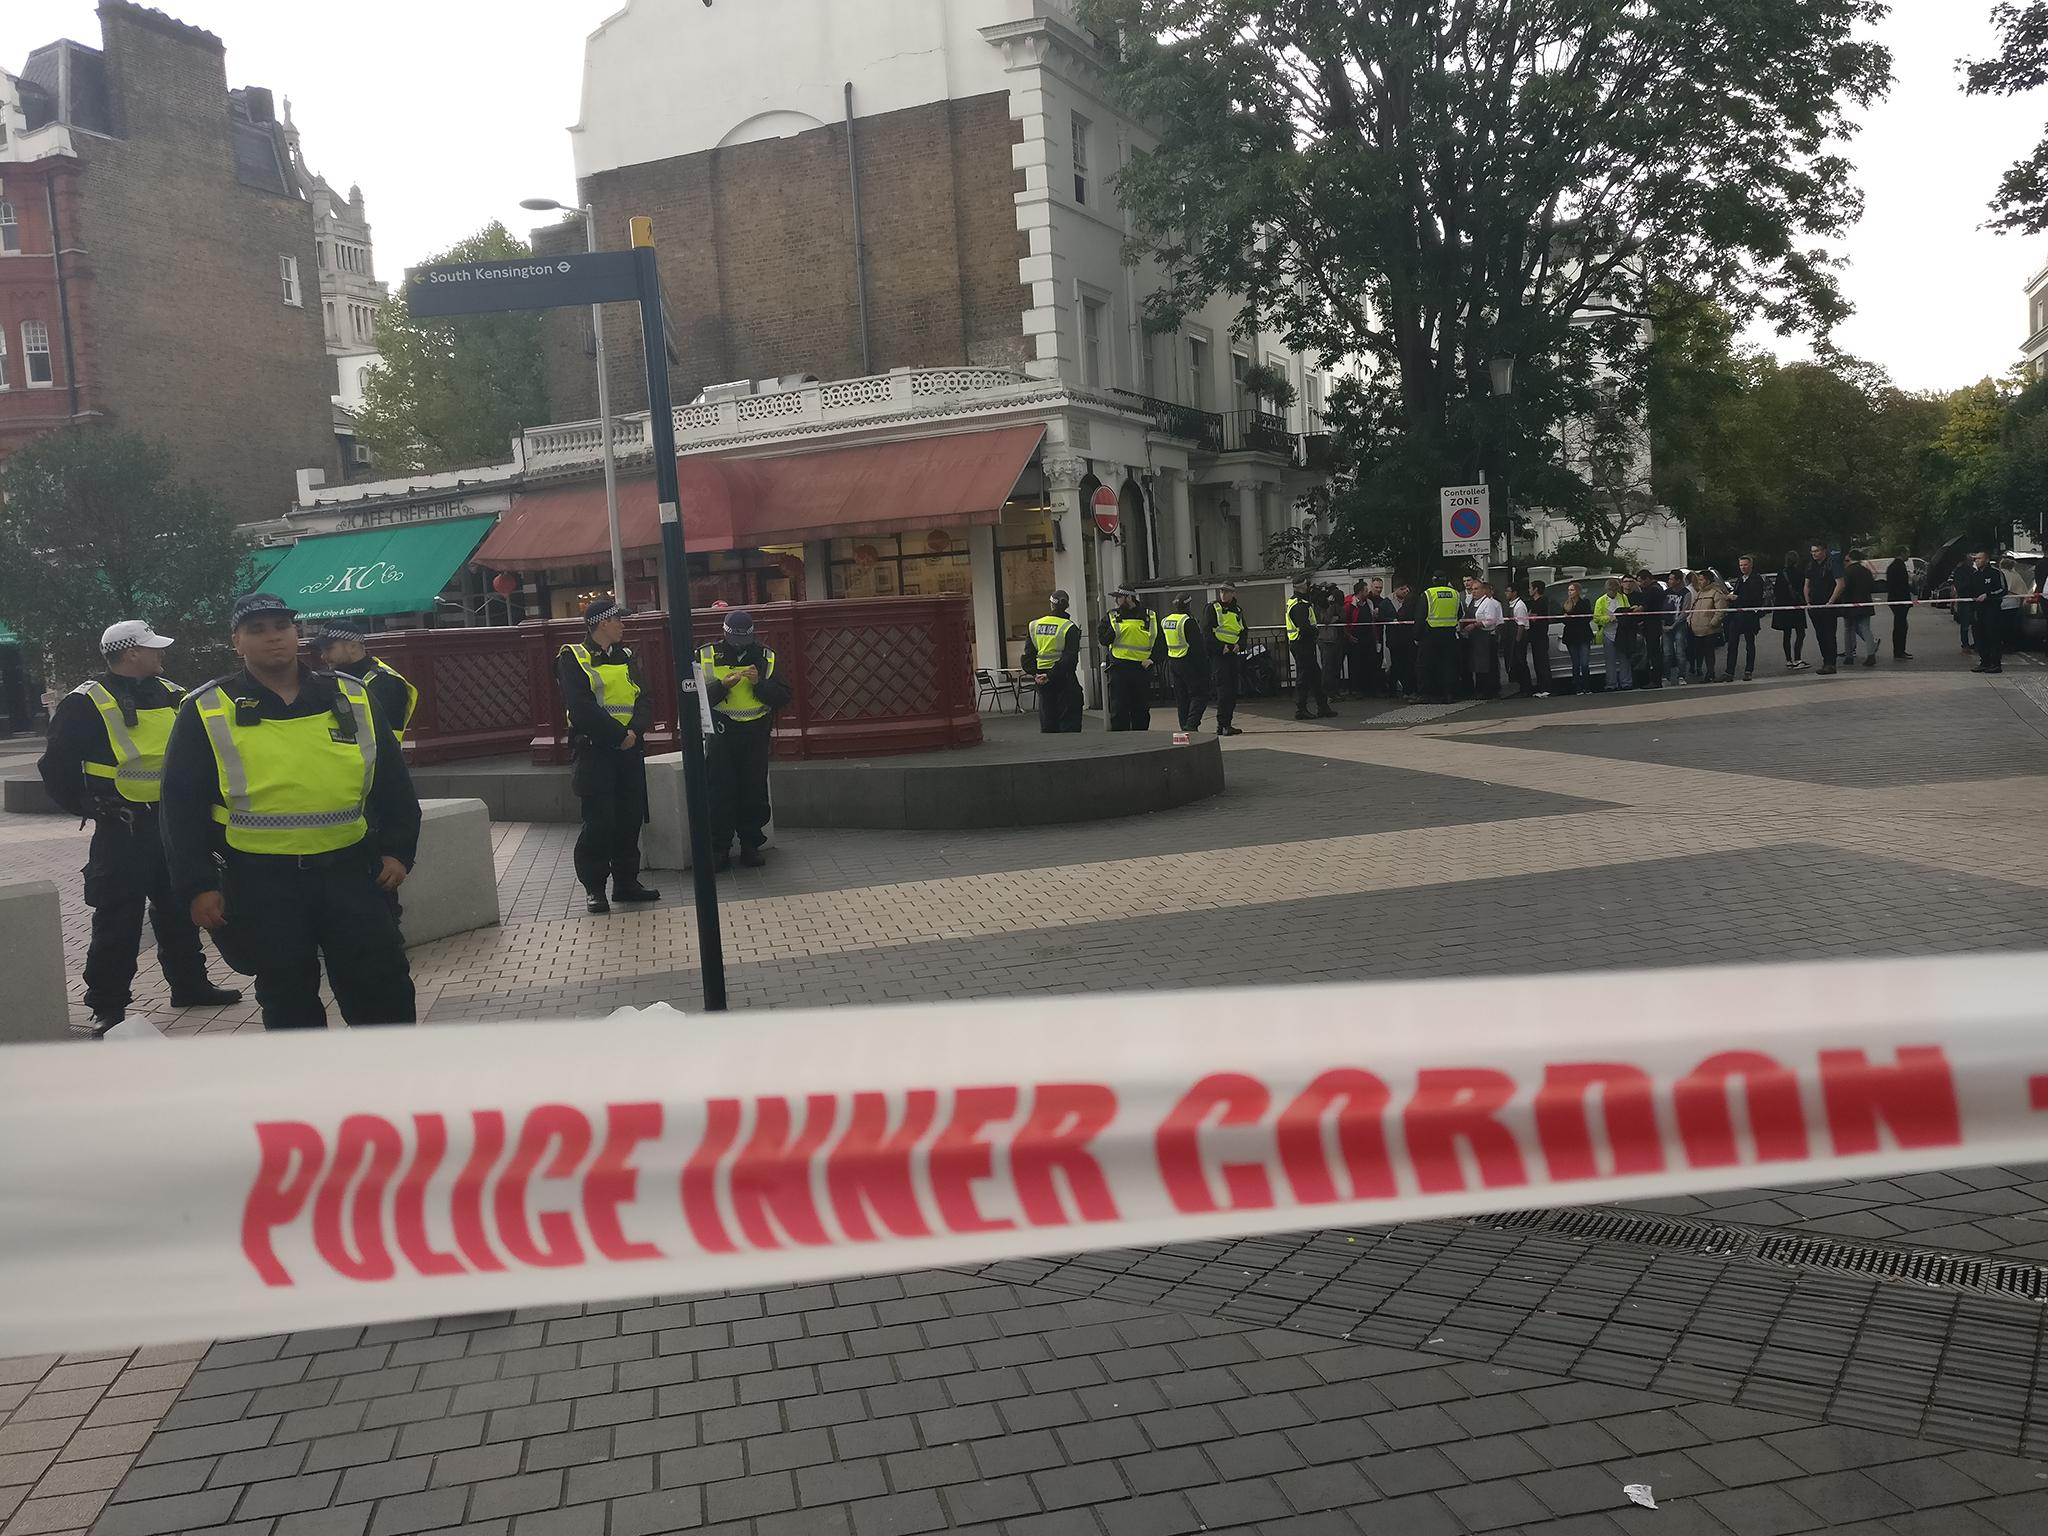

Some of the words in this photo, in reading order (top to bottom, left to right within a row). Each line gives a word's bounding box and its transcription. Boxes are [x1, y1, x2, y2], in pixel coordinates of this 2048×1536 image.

[430, 269, 471, 283] South
[475, 264, 553, 280] Kensington
[1443, 488, 1486, 497] Controlled
[1450, 497, 1479, 506] ZONE
[330, 562, 386, 593] KC
[1037, 625, 1058, 634] POLICE
[241, 1102, 668, 1287] POLICE
[680, 1082, 1122, 1255] INNER
[1155, 1046, 1964, 1215] CORDON
